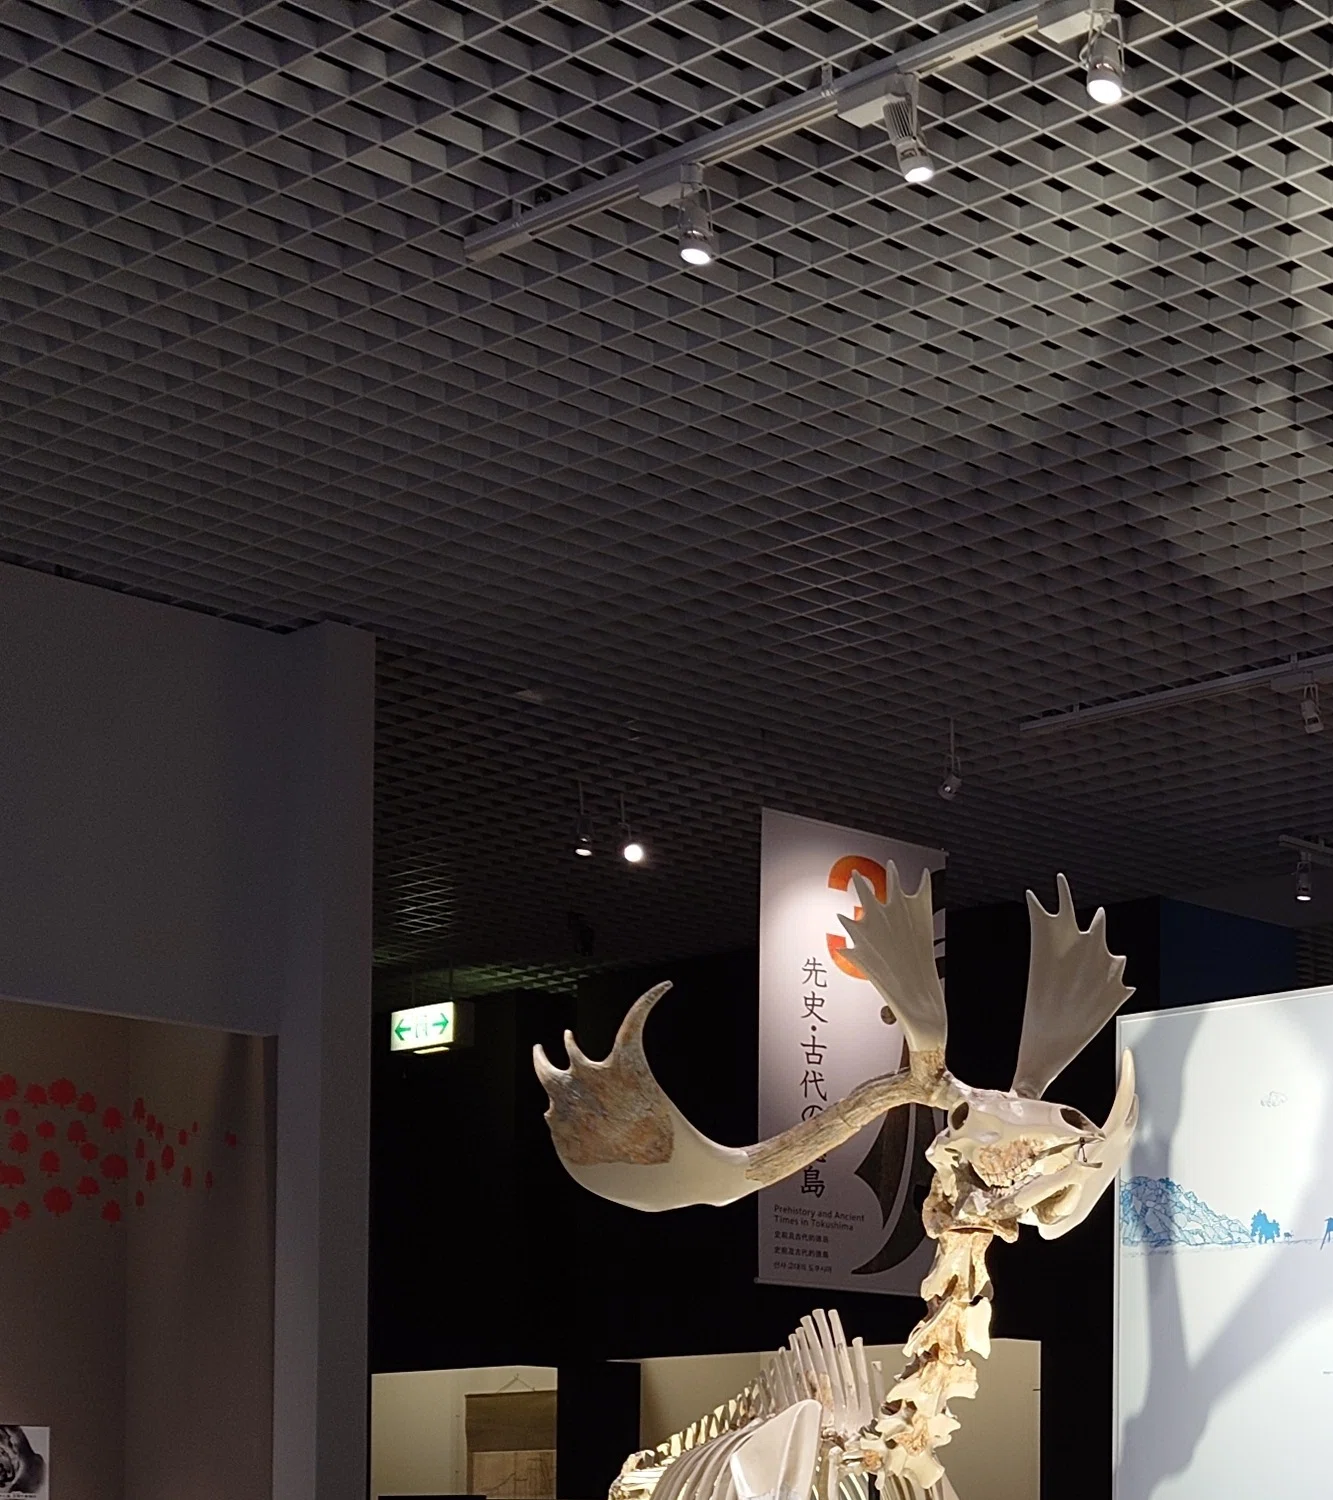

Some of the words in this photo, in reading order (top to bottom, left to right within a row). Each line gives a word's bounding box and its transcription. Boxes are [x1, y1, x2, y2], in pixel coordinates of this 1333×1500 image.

[801, 957, 828, 1199] 先史・古代の島
[774, 1204, 816, 1217] Prehistory
[817, 1210, 833, 1219] and
[834, 1211, 865, 1222] Ancient
[774, 1215, 799, 1225] Times
[811, 1219, 854, 1231] Tokushima
